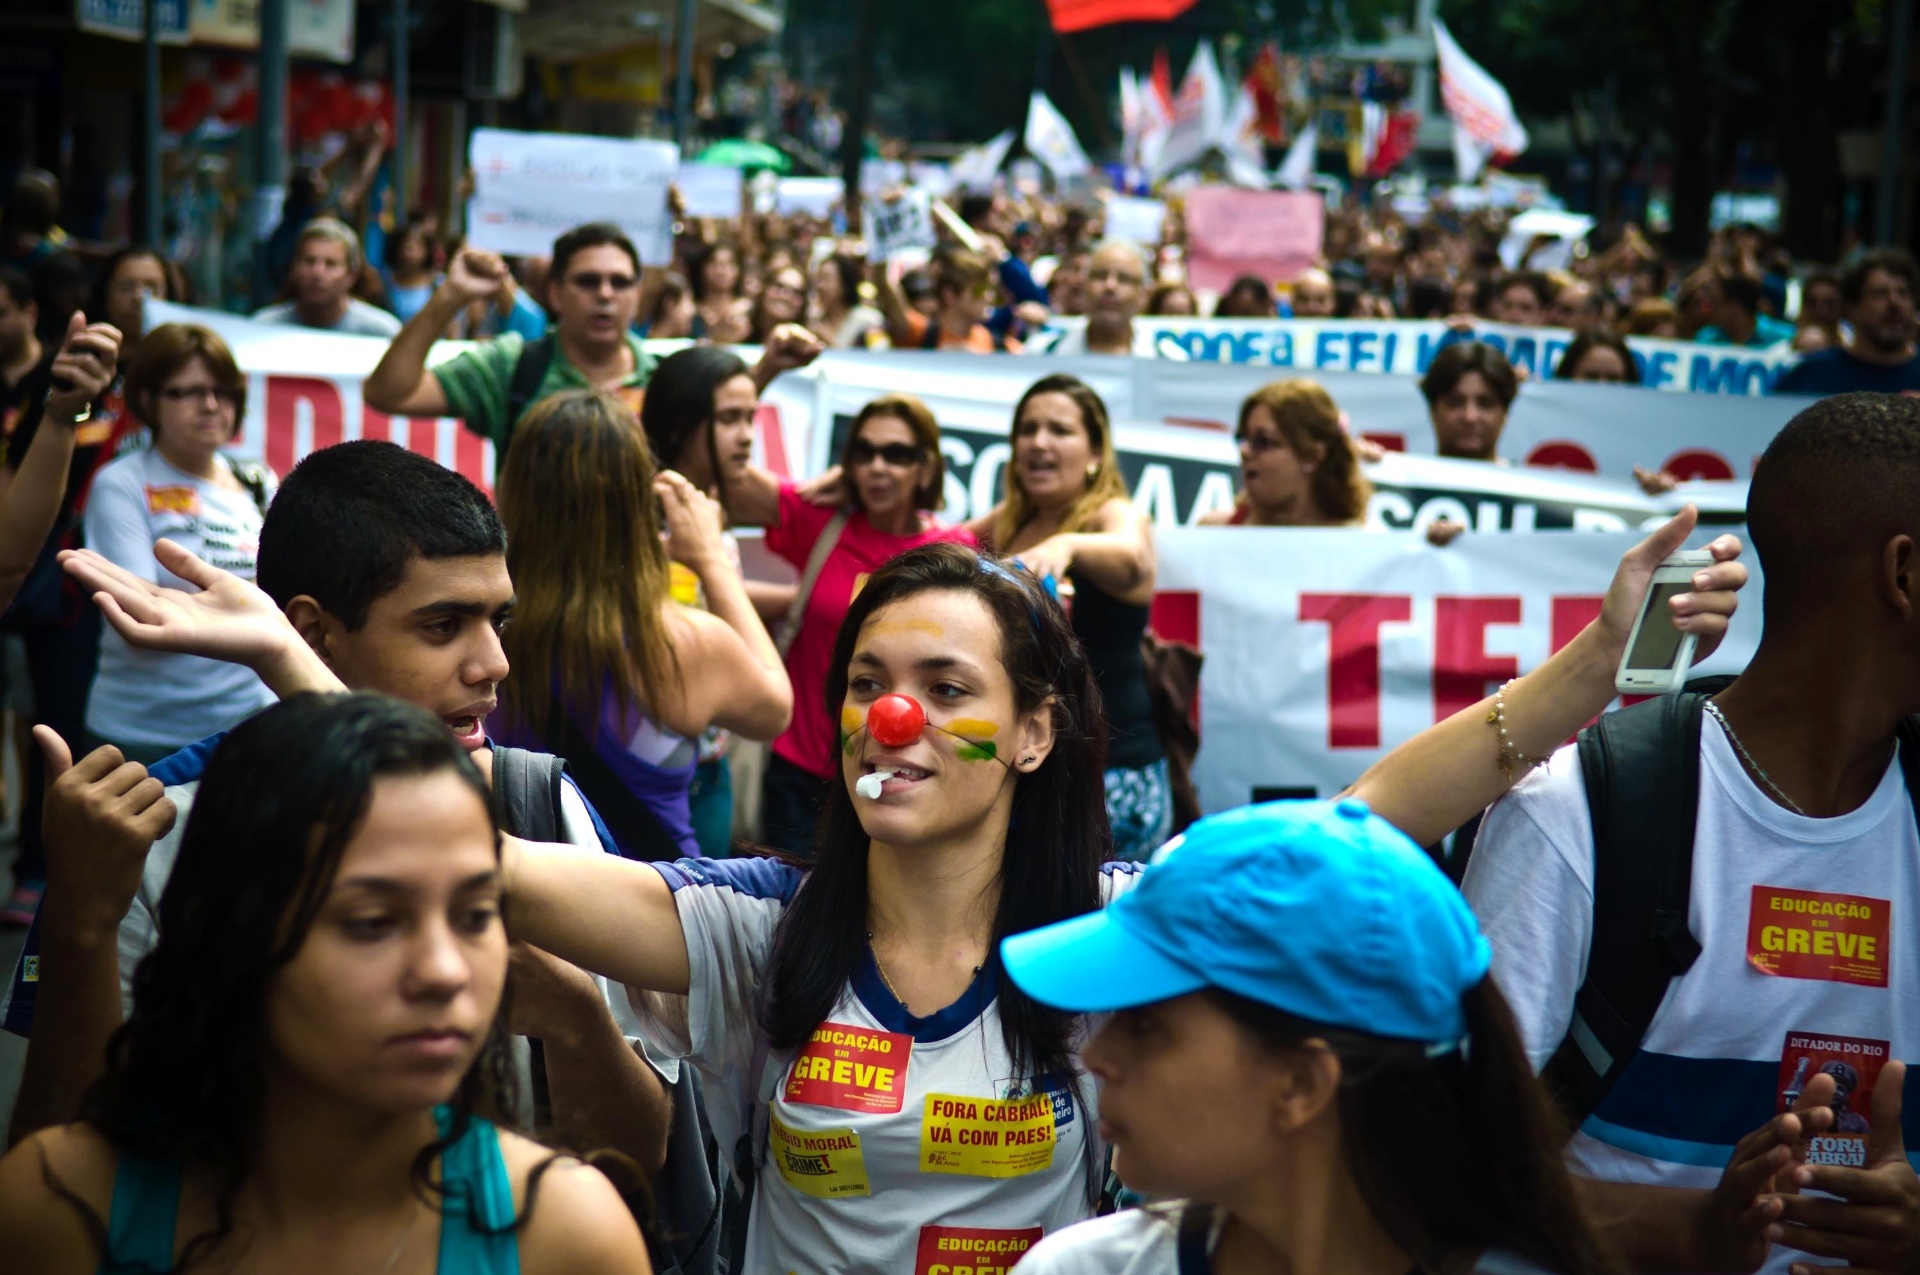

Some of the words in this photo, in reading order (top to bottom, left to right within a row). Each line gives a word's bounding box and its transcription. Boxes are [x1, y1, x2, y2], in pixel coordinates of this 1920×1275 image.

[1770, 897, 1871, 920] EDUCAÇÃO
[1812, 919, 1829, 927] EM
[1761, 925, 1877, 961] GREVE
[809, 1029, 892, 1053] DUCAÇÃO
[1790, 1037, 1841, 1052] DITADOR
[1843, 1043, 1860, 1053] DO
[1863, 1045, 1883, 1056] RIO
[834, 1049, 850, 1058] EM
[794, 1056, 895, 1092] GREVE
[932, 1099, 977, 1119] FORA
[983, 1098, 1050, 1121] CABRAL!
[804, 1136, 857, 1151] MORAL
[930, 1122, 953, 1143] VÁ
[958, 1129, 998, 1146] COM
[1005, 1124, 1051, 1146] PAES!
[1810, 1137, 1865, 1153] FORA
[785, 1154, 835, 1174] CRIME!
[1804, 1151, 1865, 1167] ABRA
[937, 1236, 1029, 1255] EDUCAÇÃO
[976, 1256, 990, 1264] EM
